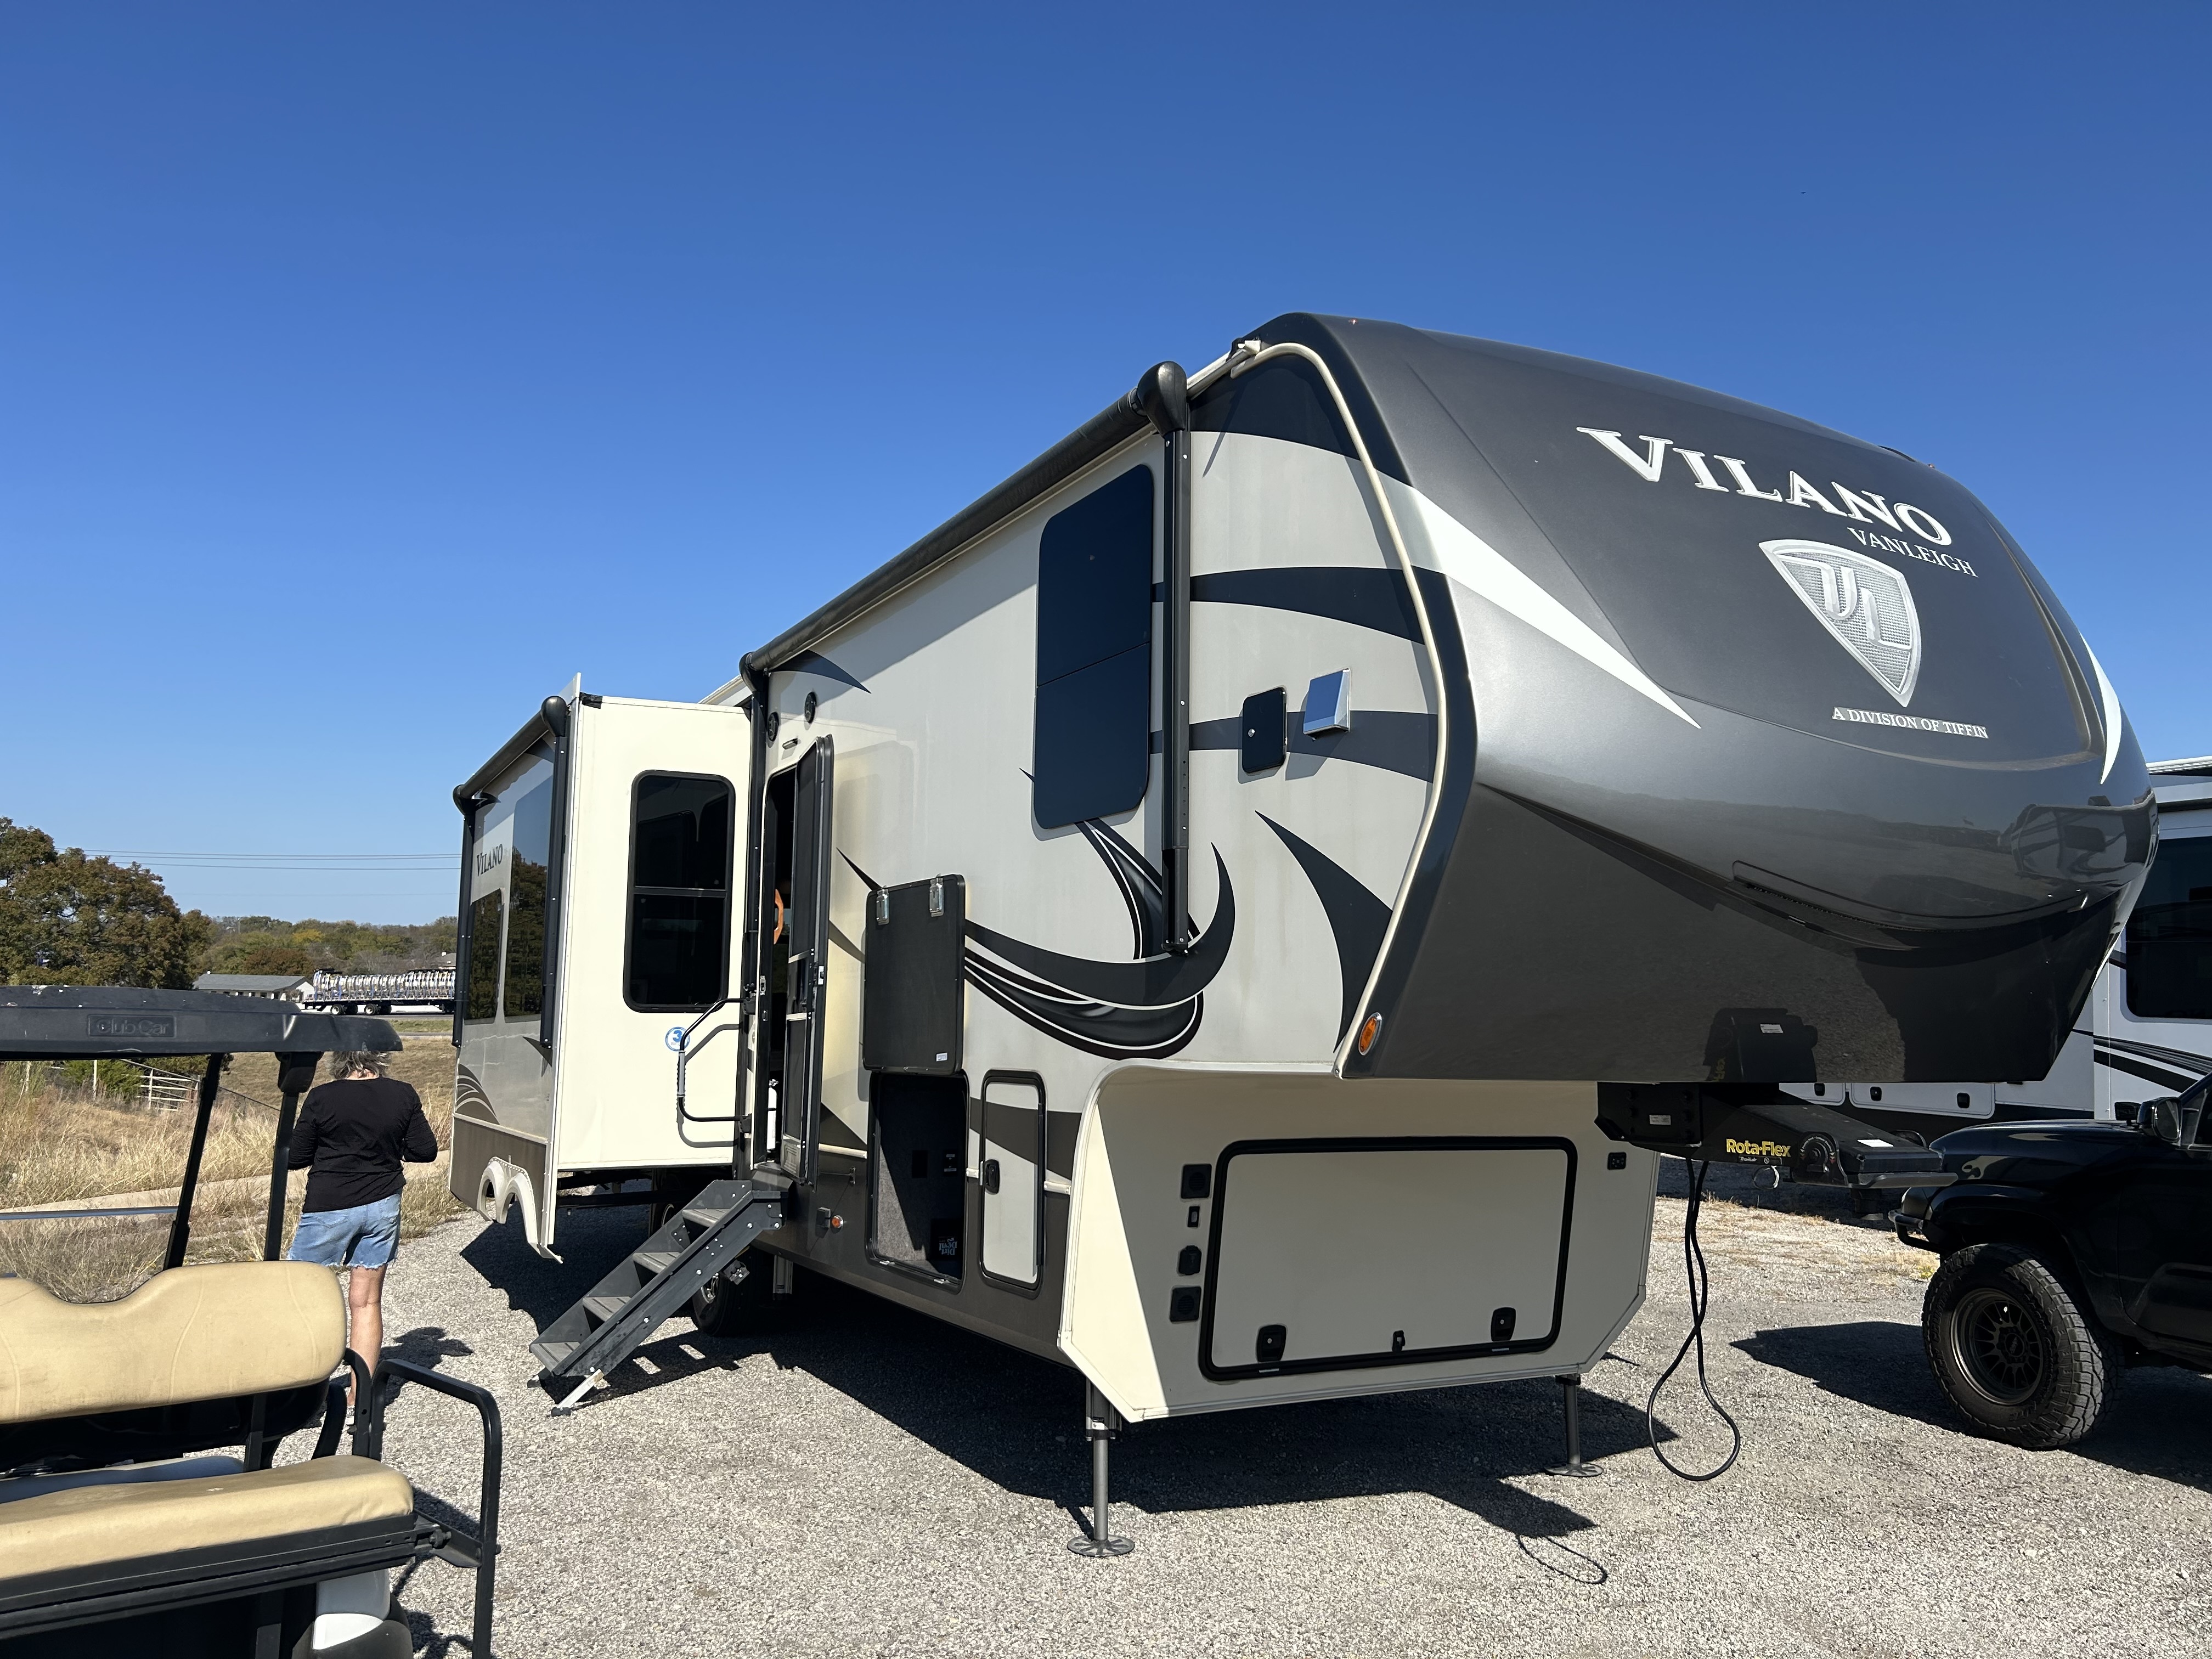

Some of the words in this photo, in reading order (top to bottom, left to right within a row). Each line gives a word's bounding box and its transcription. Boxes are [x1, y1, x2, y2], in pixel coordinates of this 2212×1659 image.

[1576, 427, 1953, 546] VILANO
[1847, 527, 1979, 578] VANLEIGH
[1832, 708, 1846, 720] A
[1847, 708, 1918, 730] DIVISION
[1921, 718, 1940, 732] OF
[1942, 721, 1989, 739] TIFFIN
[476, 844, 503, 877] VILANO
[95, 1018, 136, 1034] Club
[138, 1019, 170, 1036] Car
[939, 1237, 957, 1251] Devil
